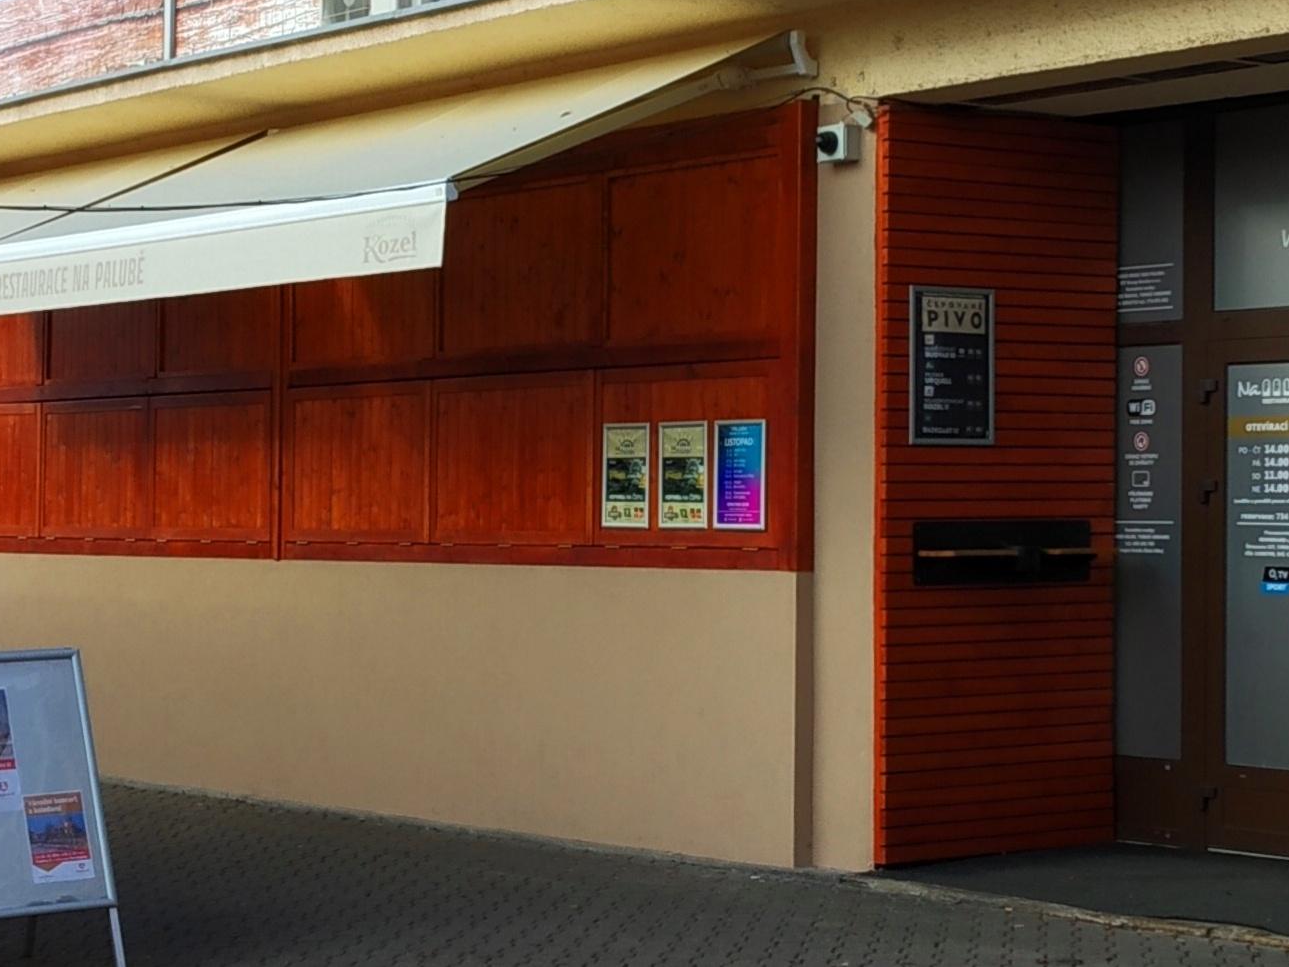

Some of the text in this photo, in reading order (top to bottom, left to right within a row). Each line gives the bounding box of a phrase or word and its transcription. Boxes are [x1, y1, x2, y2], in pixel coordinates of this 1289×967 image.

[361, 229, 417, 264] Kozel
[72, 263, 90, 293] NA
[927, 310, 983, 330] PIVO
[1245, 420, 1288, 432] OTEVÍRACÍ
